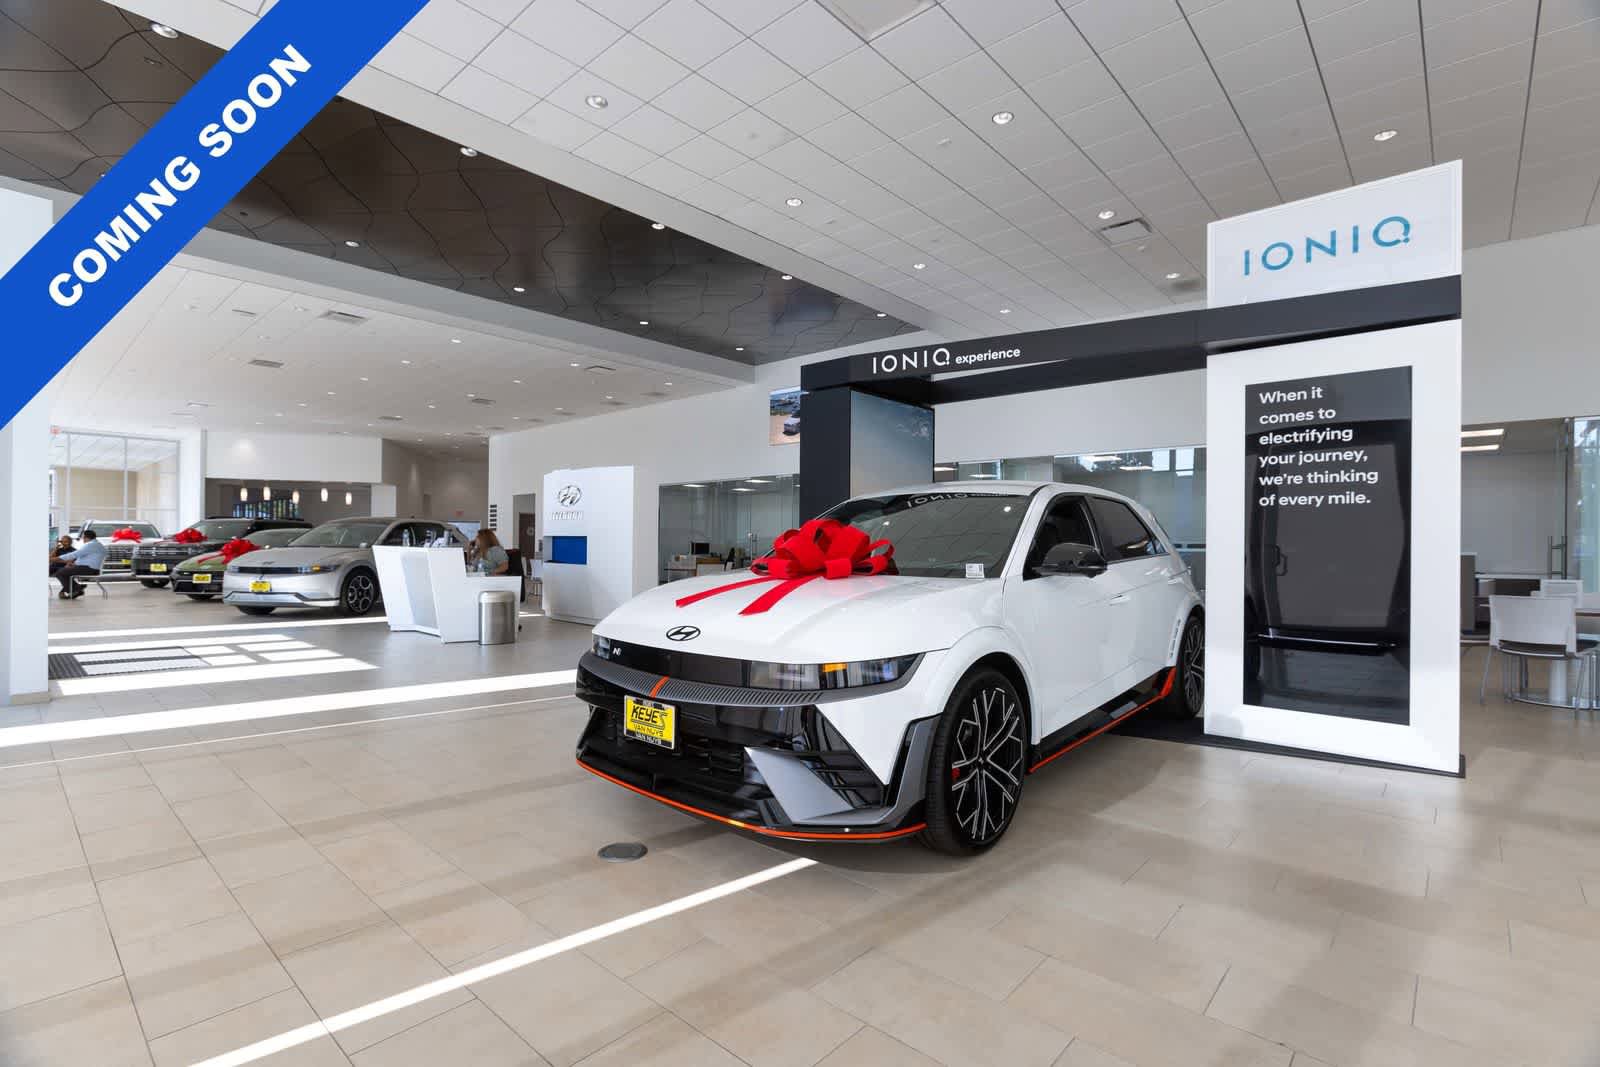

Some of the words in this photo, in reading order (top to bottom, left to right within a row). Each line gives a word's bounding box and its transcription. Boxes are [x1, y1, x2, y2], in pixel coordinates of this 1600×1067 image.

[1243, 216, 1411, 276] IONIQ
[872, 347, 950, 374] IONIQ
[955, 348, 1021, 364] experience
[1259, 390, 1308, 404] When
[1311, 386, 1323, 399] it
[1259, 410, 1315, 424] comes
[1317, 408, 1336, 420] to
[1259, 427, 1353, 445] electrifying
[1258, 455, 1296, 468] your
[1298, 449, 1368, 466] journey,
[1258, 473, 1303, 486] we're
[1306, 469, 1379, 484] thinking
[1259, 494, 1276, 506] of
[1278, 495, 1325, 507] every
[1328, 491, 1371, 504] mile.
